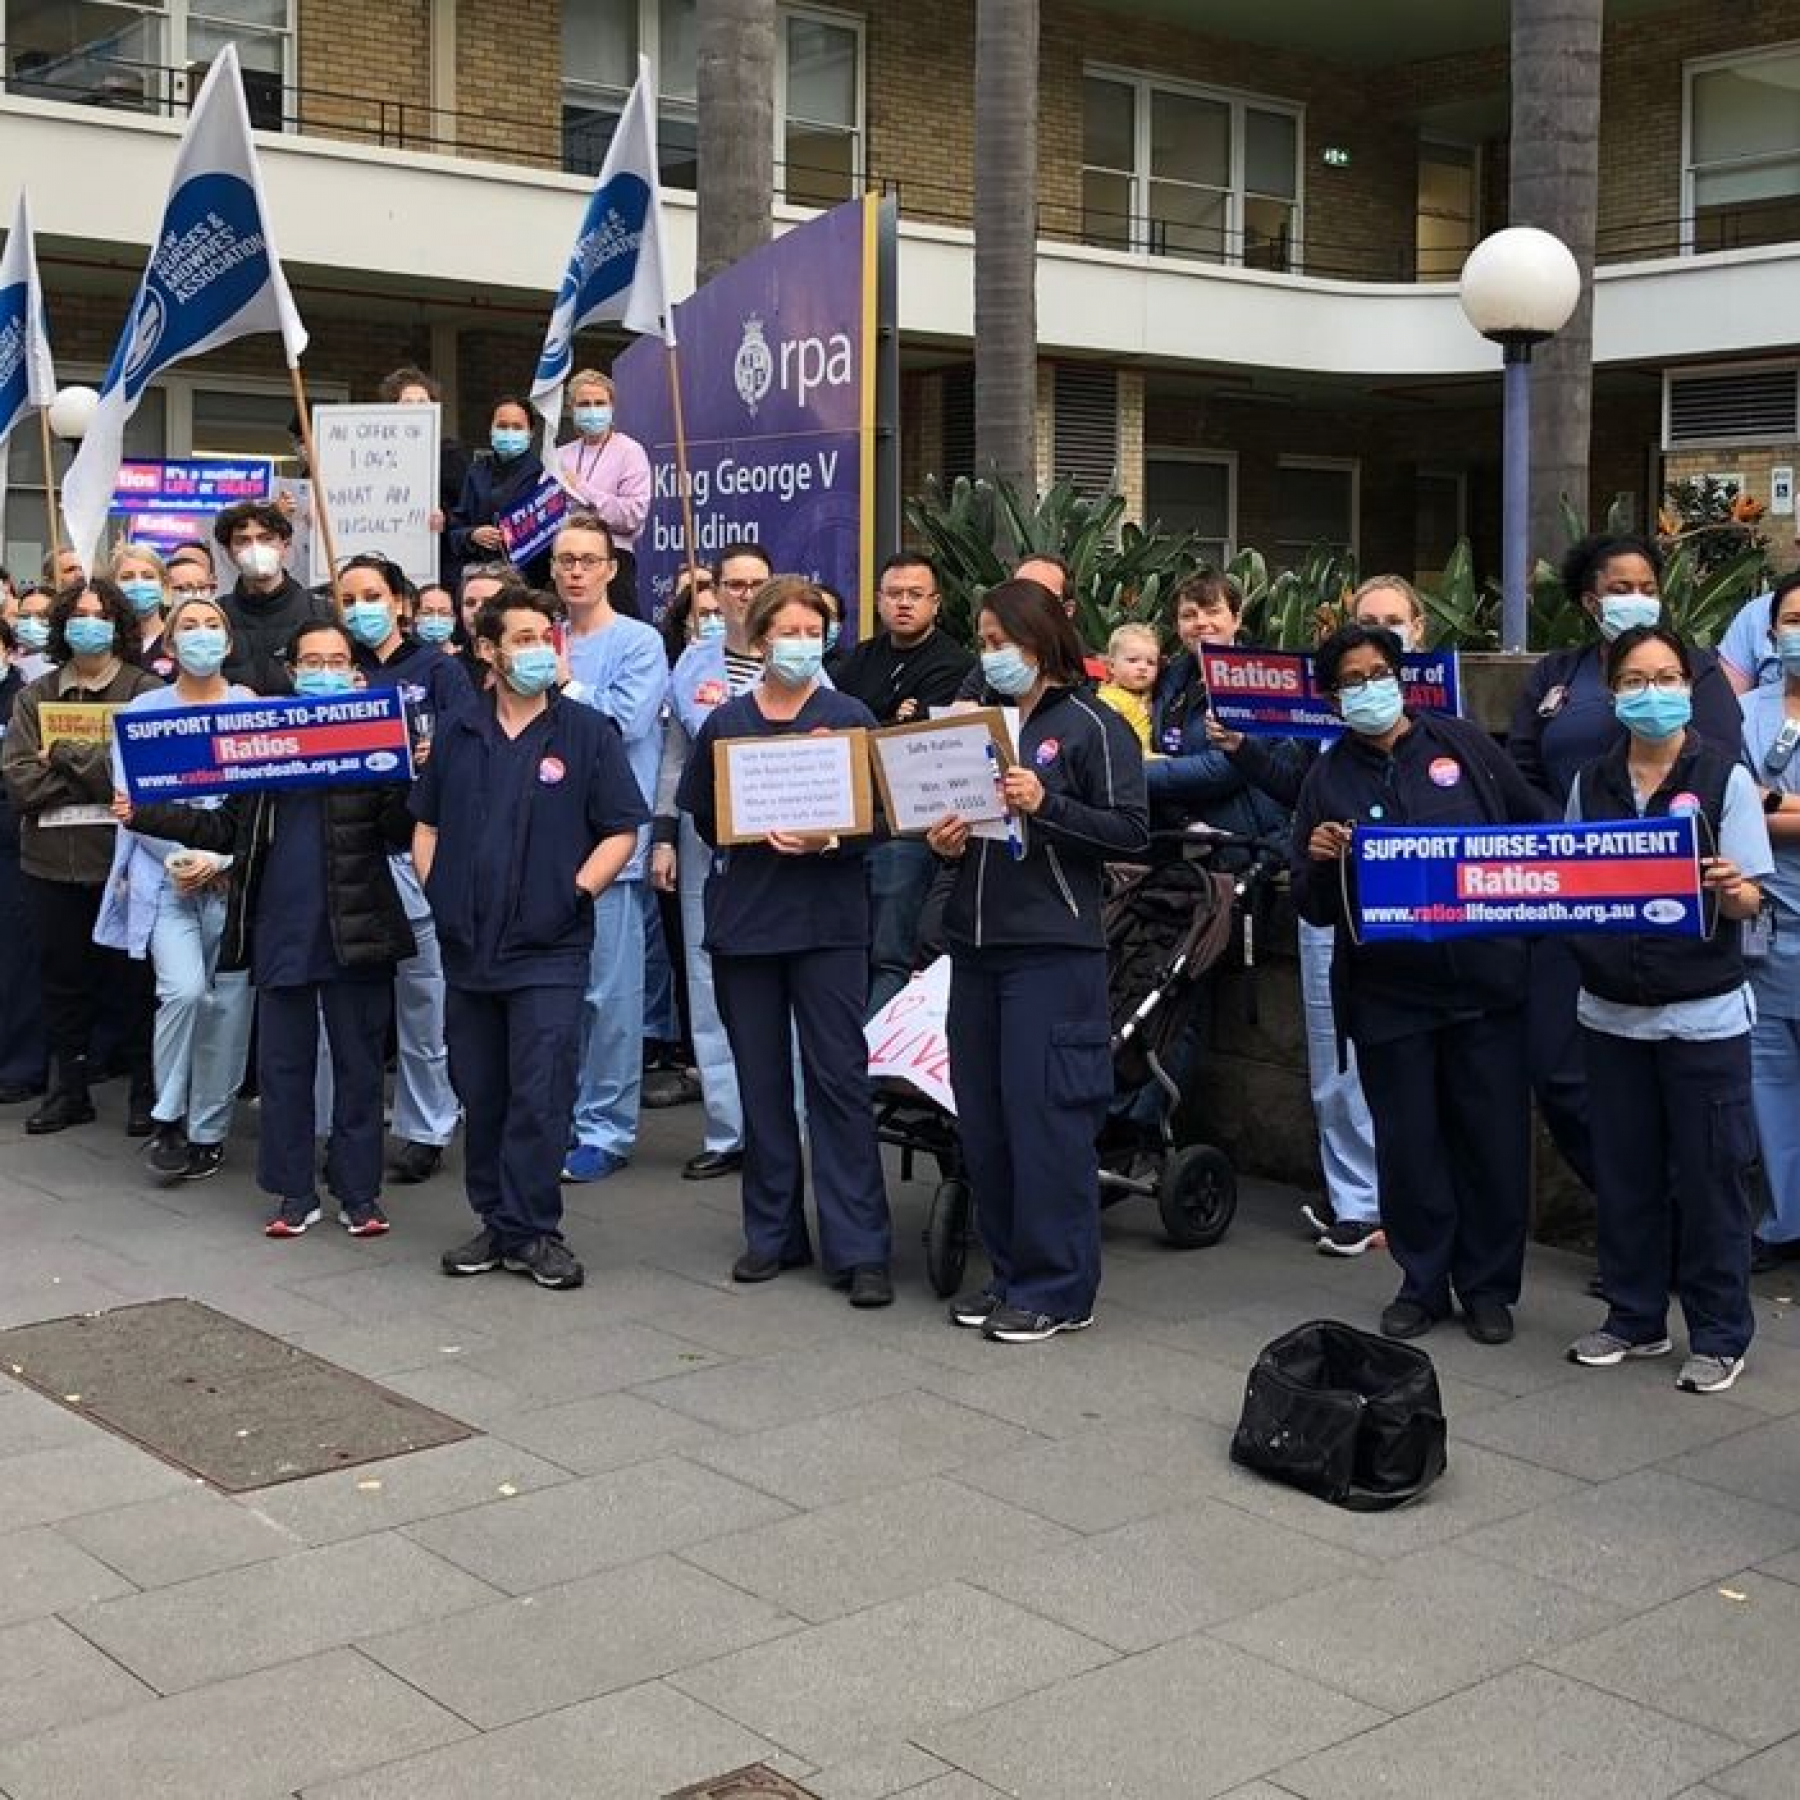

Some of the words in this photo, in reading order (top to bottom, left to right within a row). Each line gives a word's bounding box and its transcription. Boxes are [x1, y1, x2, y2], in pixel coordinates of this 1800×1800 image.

[780, 334, 851, 408] rpa
[654, 463, 710, 506] King
[716, 457, 812, 503] George
[818, 450, 838, 489] V
[653, 512, 759, 551] bulding
[1210, 659, 1299, 690] Ratios
[1425, 662, 1445, 684] of
[126, 716, 211, 741] SUPPORT
[215, 698, 391, 733] NURSE-TO-PATIENT
[218, 735, 300, 761] Ratios
[136, 756, 361, 789] www.ratioslifeordeath.org.au
[1362, 836, 1459, 861] SUPPORT
[1464, 831, 1680, 857] NURSE-TO-PATIENT
[1463, 865, 1560, 895] Ratios
[1361, 902, 1636, 925] www.ratioslifeordeath.org.au
